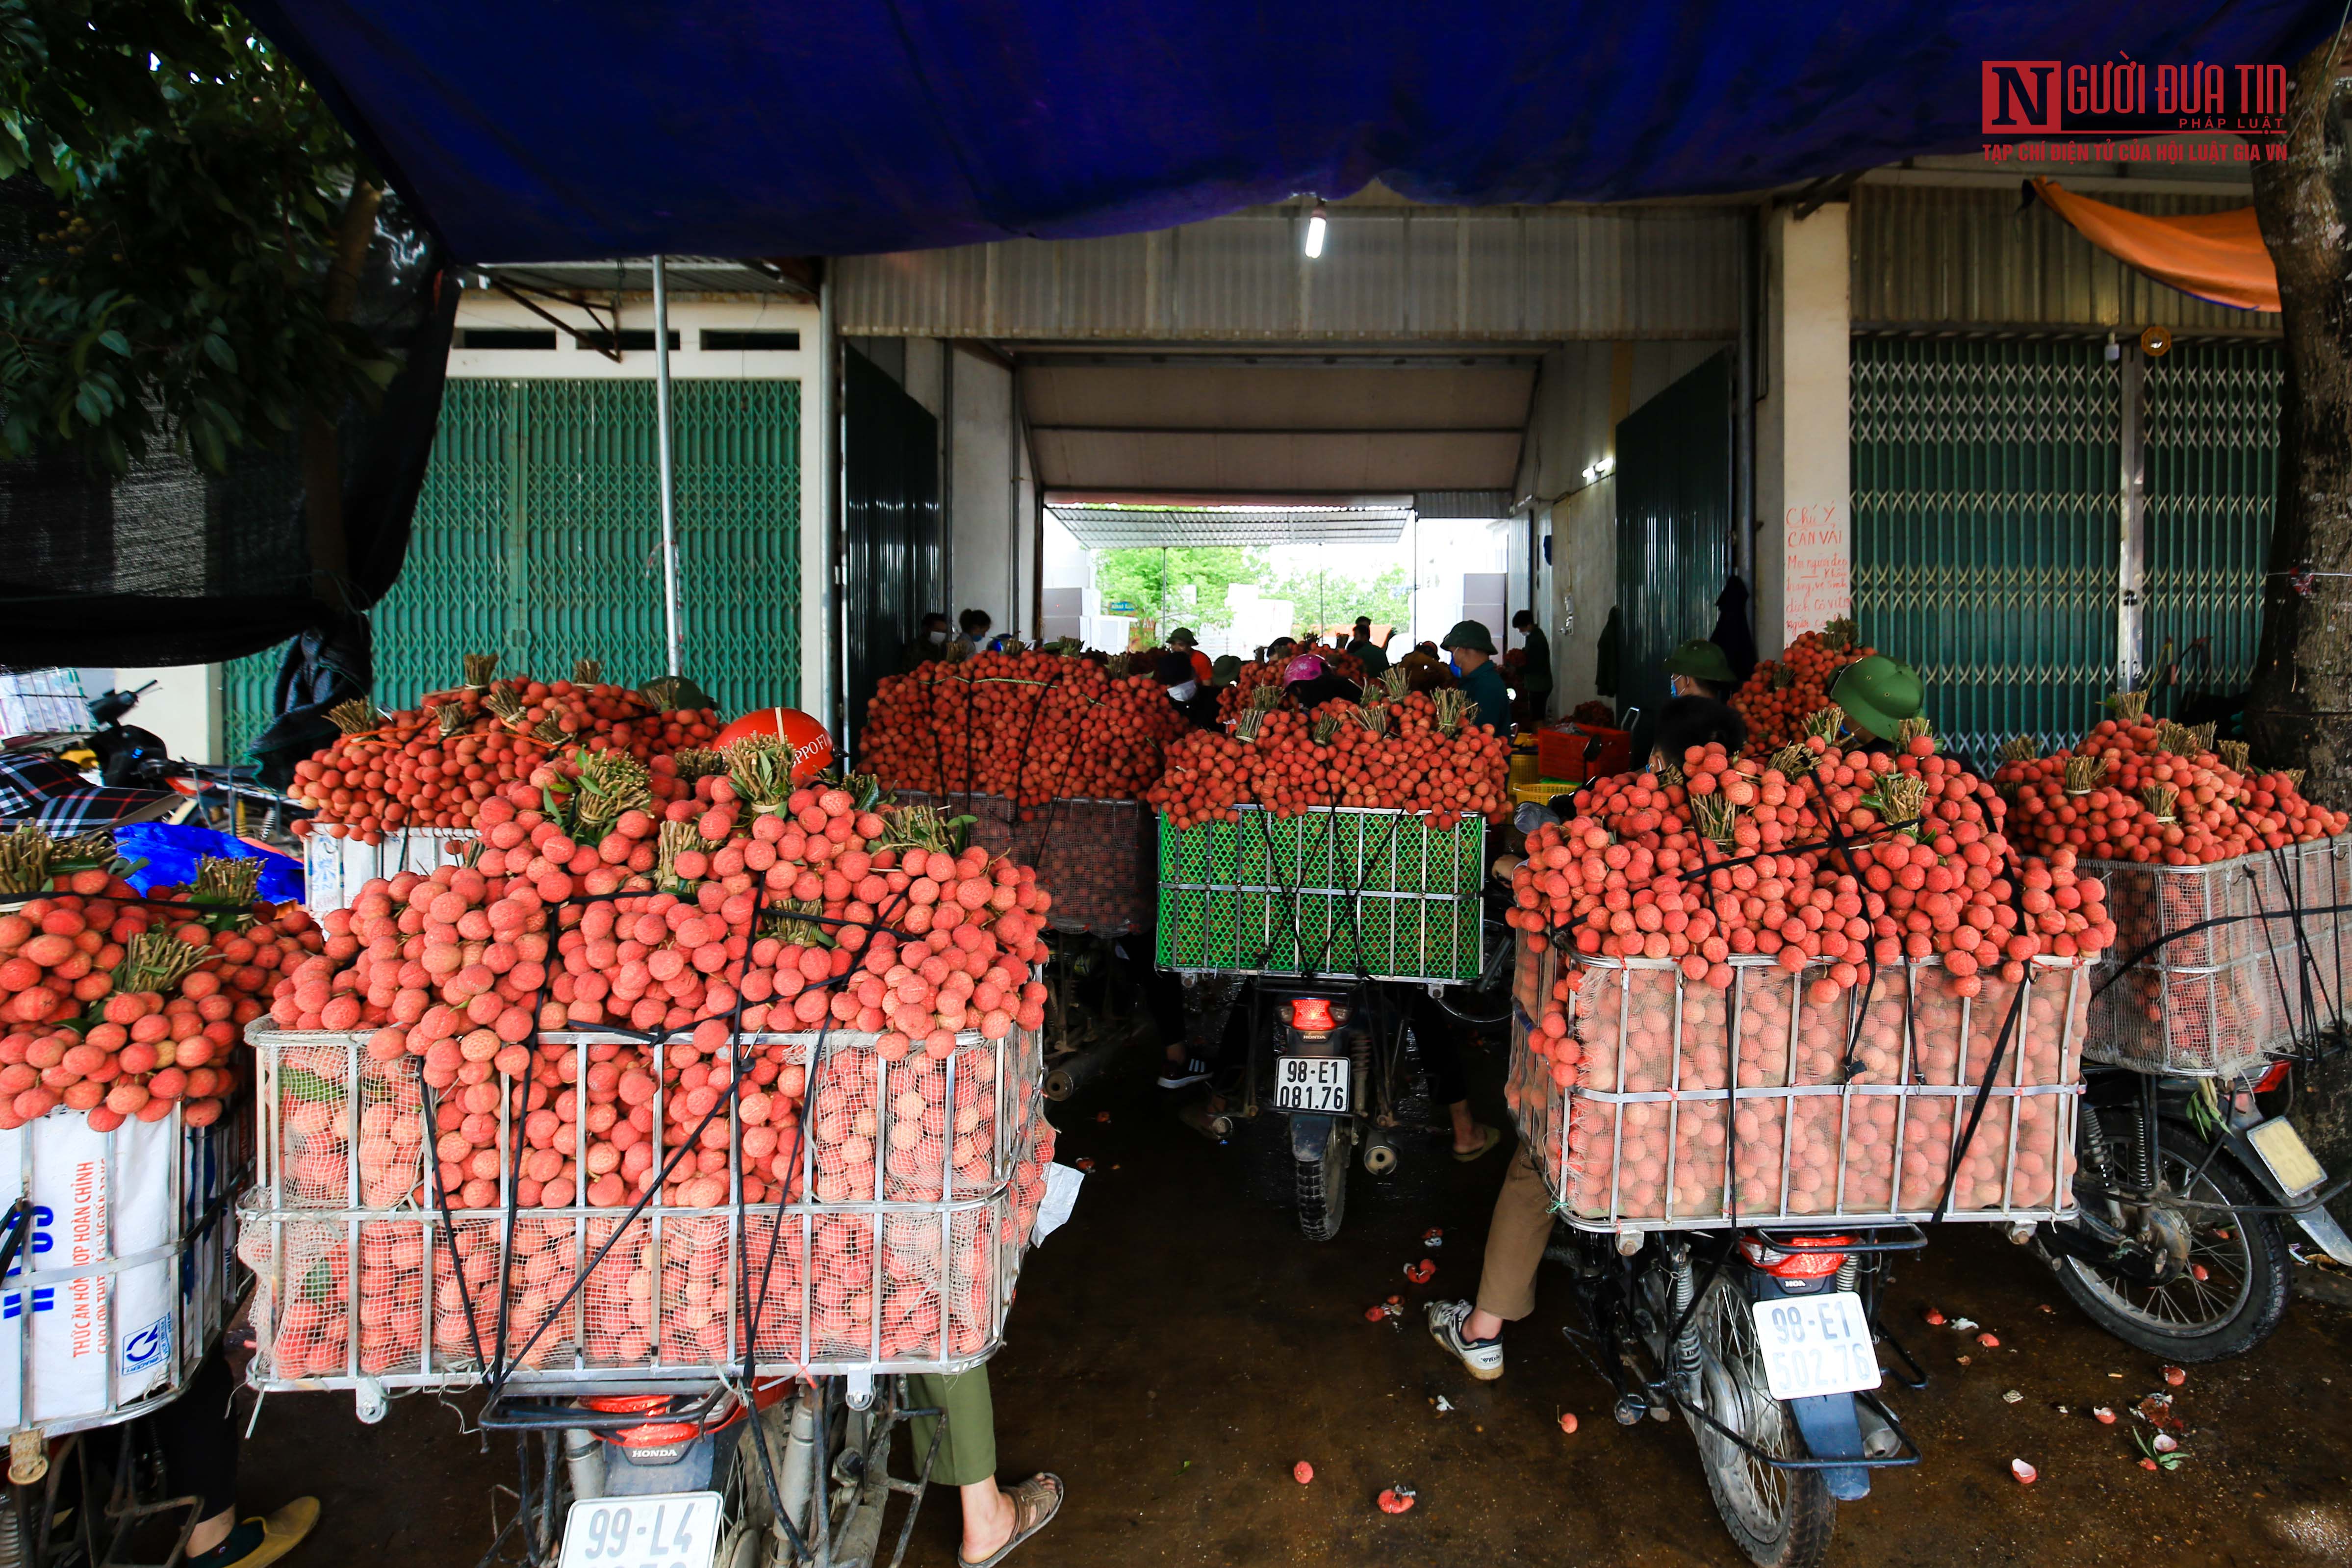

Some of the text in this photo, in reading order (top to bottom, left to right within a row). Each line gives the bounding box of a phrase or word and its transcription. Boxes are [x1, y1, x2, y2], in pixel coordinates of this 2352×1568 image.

[792, 741, 818, 768] PPO
[1287, 1061, 1338, 1084] 98-E1
[1279, 1086, 1344, 1110] 081.76
[71, 1205, 91, 1242] HOÀN
[72, 1303, 91, 1320] ĂN
[1771, 1301, 1851, 1344] 98-E1
[1773, 1343, 1871, 1390] 502.76
[632, 1449, 678, 1458] HONDA
[585, 1502, 696, 1560] 99-L4
